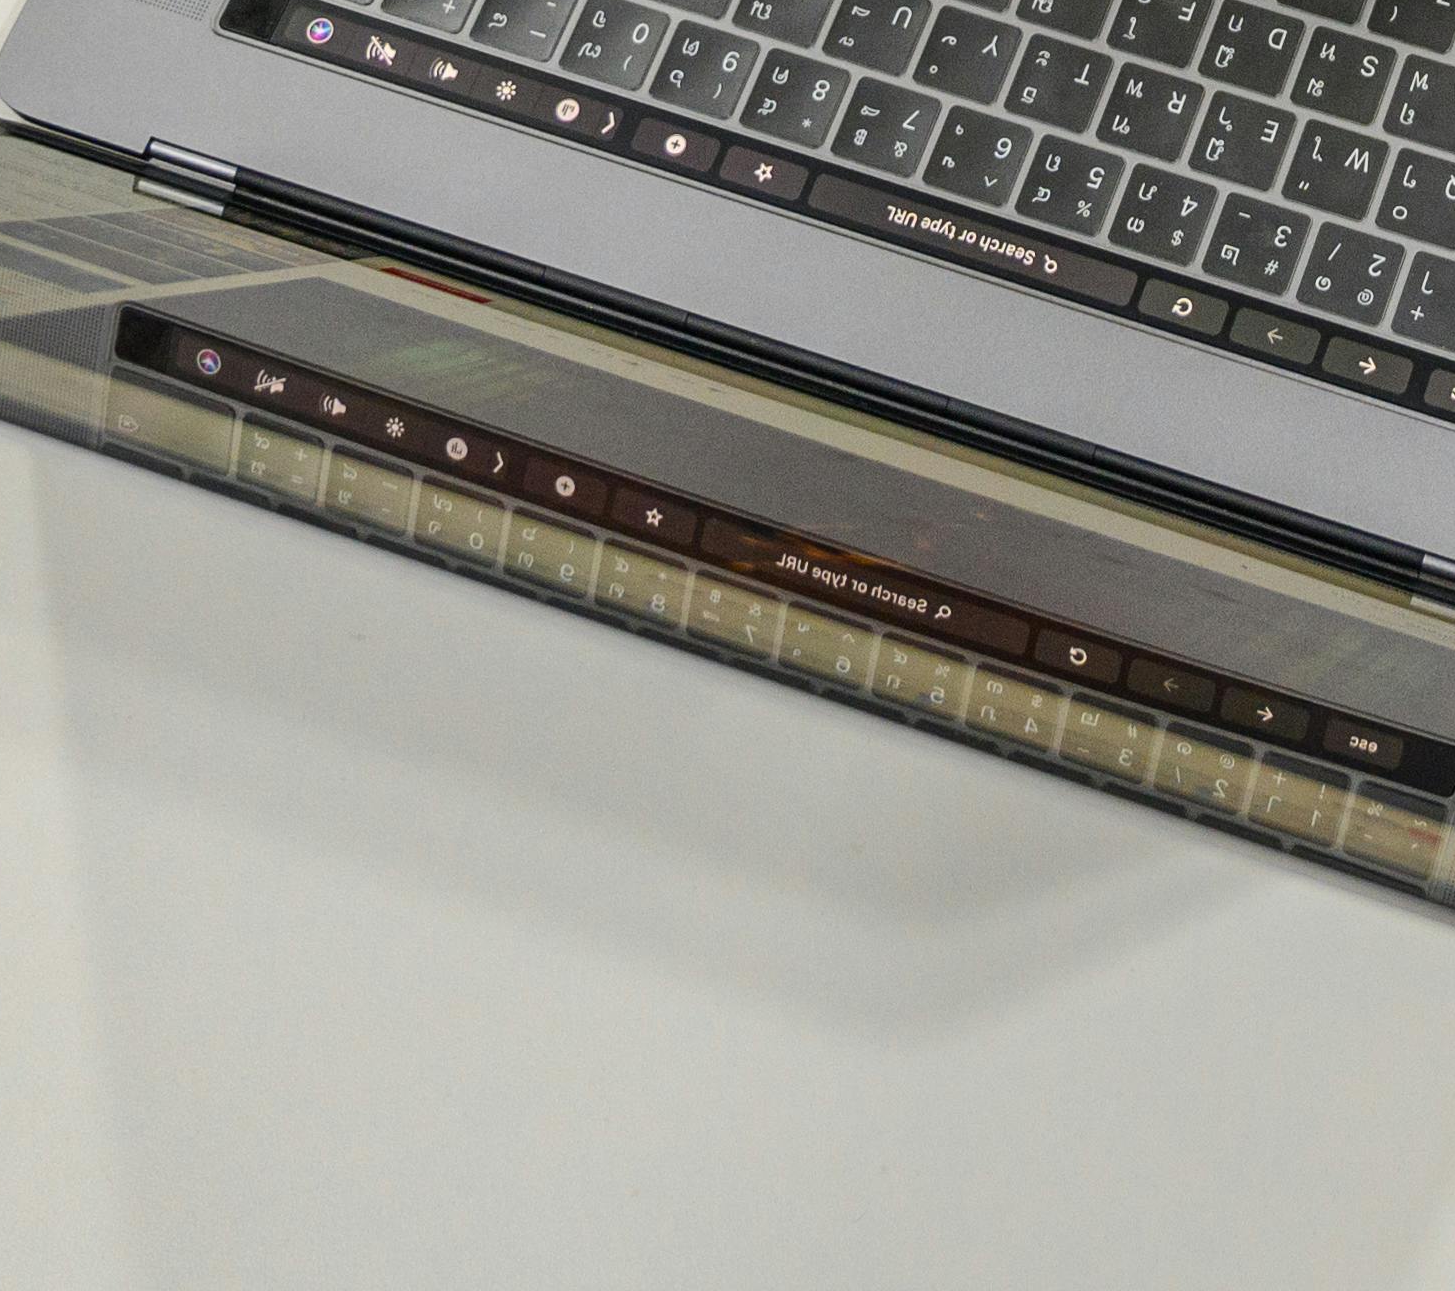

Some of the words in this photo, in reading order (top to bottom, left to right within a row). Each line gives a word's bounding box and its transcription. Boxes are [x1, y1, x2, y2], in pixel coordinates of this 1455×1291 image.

[590, 8, 606, 28] จ
[890, 5, 913, 29] U
[1176, 0, 1197, 22] F
[630, 21, 650, 44] 0
[1226, 13, 1244, 33] ก
[680, 36, 700, 57] ต
[980, 34, 998, 57] Y
[1266, 26, 1288, 50] D
[720, 49, 740, 72] 9
[1318, 41, 1336, 62] ห
[770, 65, 790, 85] ค
[1072, 62, 1090, 86] T
[1359, 54, 1379, 77] S
[810, 78, 831, 101] 8
[1124, 77, 1143, 98] พ
[1408, 69, 1429, 92] ฟ
[1166, 89, 1187, 114] R
[900, 108, 920, 131] 7
[1259, 118, 1279, 143] E
[992, 136, 1012, 159] 6
[1044, 152, 1061, 172] ถ
[1343, 146, 1369, 173] W
[1085, 165, 1105, 189] 5
[1401, 163, 1417, 189] ๆ
[1137, 181, 1158, 201] ภ
[886, 204, 918, 228] URL
[1179, 194, 1198, 217] 4
[919, 215, 956, 239] type
[956, 228, 977, 244] or
[1272, 224, 1292, 248] 3
[978, 233, 1036, 265] Search
[1366, 252, 1386, 277] 2
